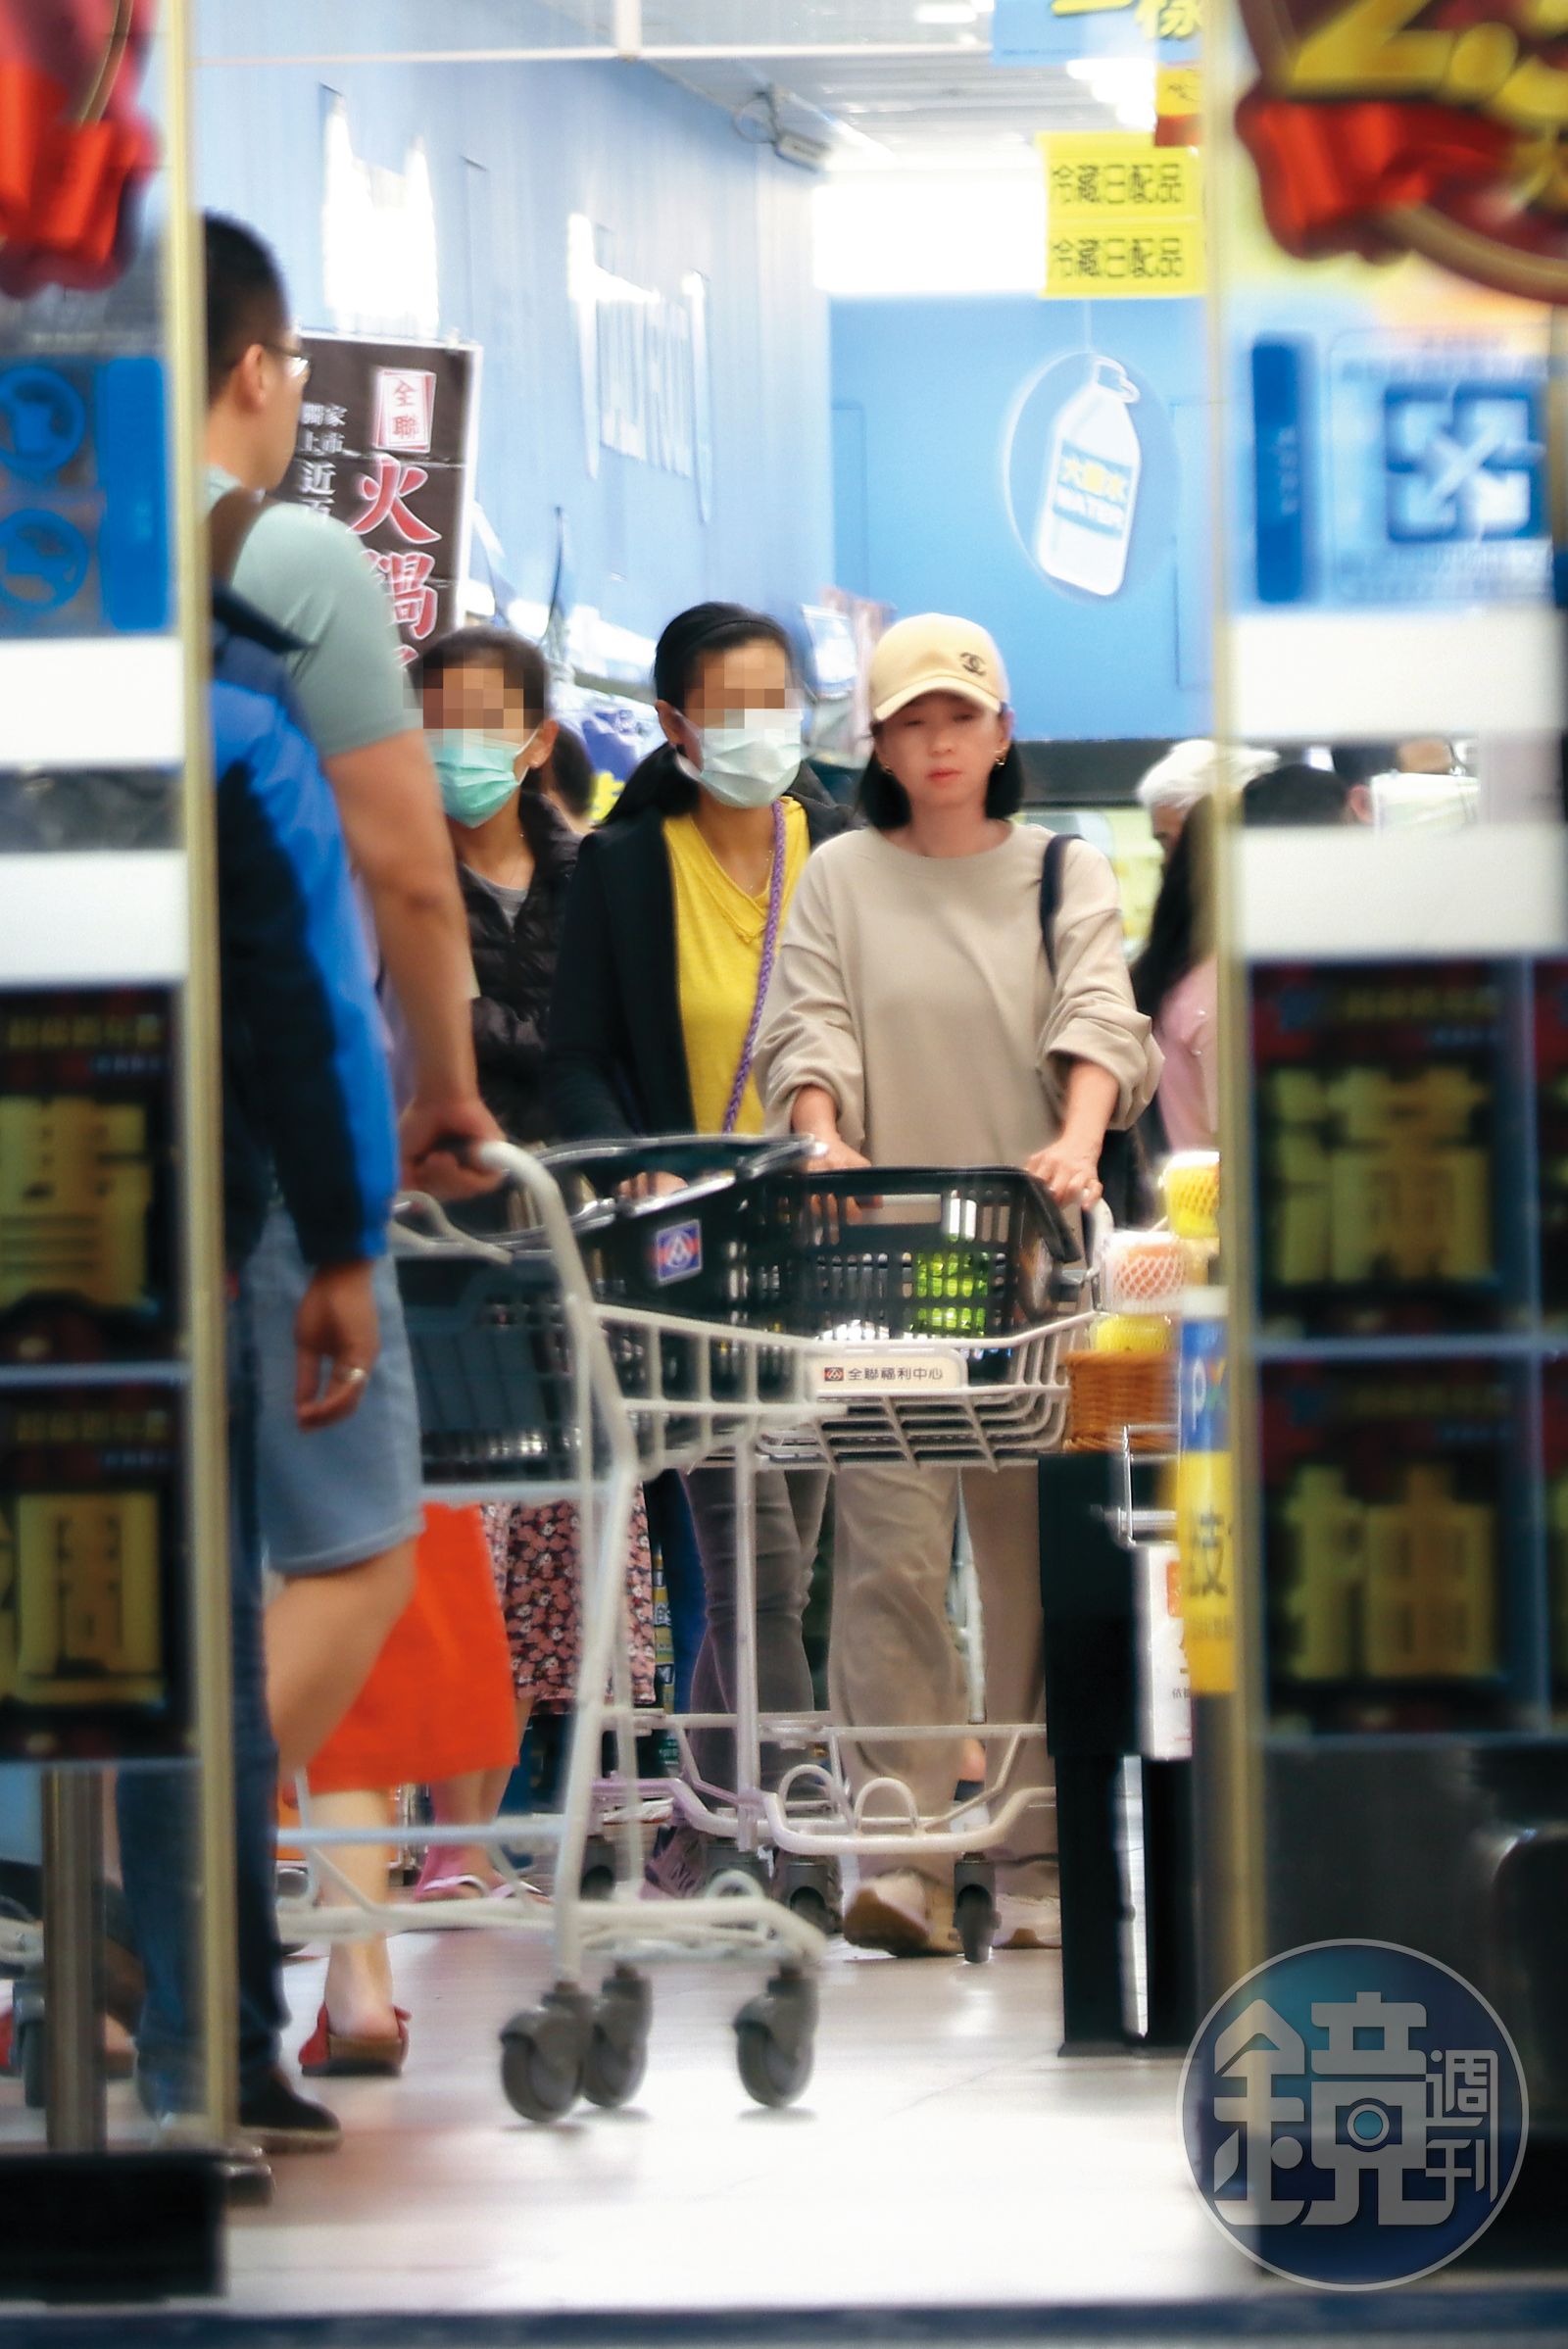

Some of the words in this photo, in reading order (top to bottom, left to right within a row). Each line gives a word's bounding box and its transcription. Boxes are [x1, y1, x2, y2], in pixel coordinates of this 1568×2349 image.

[392, 378, 417, 440] 全聯
[345, 452, 443, 668] 火鍋
[848, 1366, 943, 1381] 全聯福利中心
